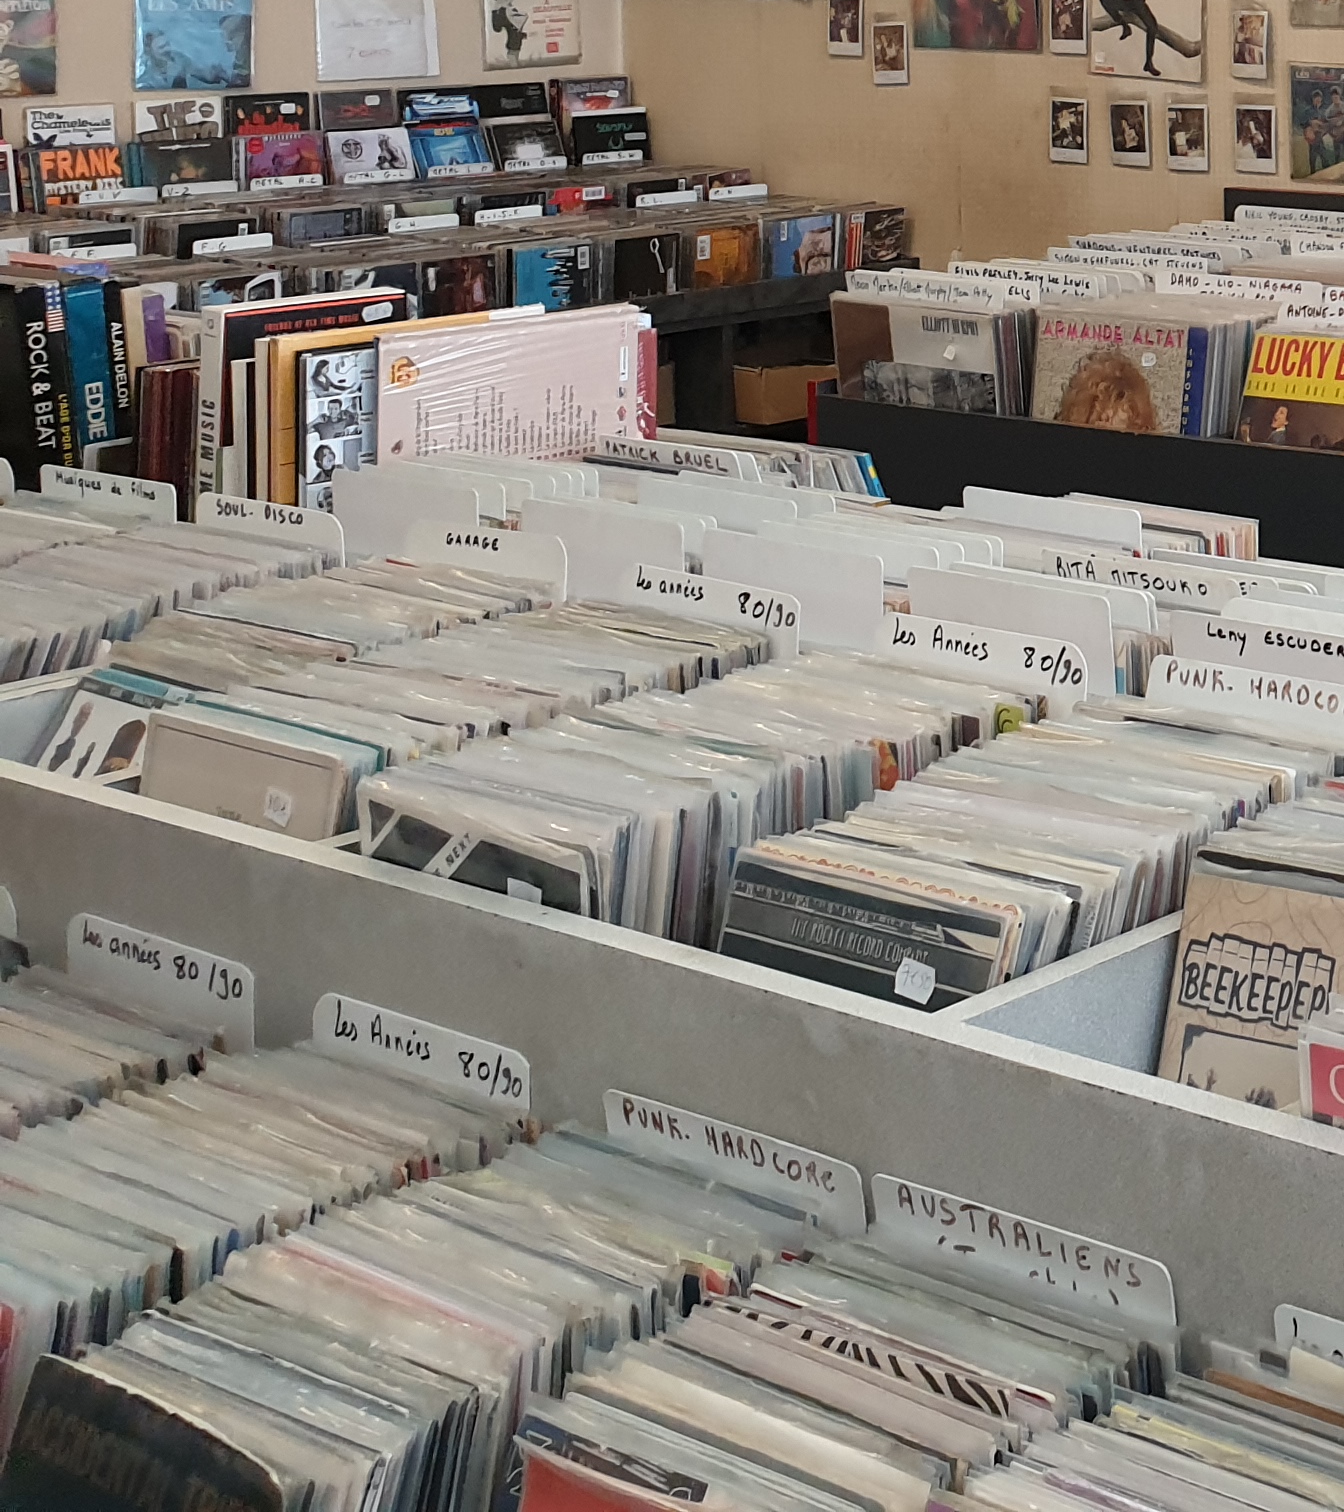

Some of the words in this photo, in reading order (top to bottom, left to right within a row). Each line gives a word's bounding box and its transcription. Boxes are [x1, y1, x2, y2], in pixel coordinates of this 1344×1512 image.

[39, 147, 124, 181] FRANK
[25, 320, 50, 380] ROCK
[110, 321, 125, 362] ALAIN
[1042, 320, 1123, 343] ARMANDE
[1251, 334, 1334, 381] LUCKY
[31, 381, 52, 396] &
[114, 362, 131, 410] DELON
[33, 399, 57, 449] BEAT
[84, 381, 107, 441] EDDIE
[201, 398, 217, 460] MUSIC
[604, 437, 668, 465] PATRICK
[673, 445, 730, 475] BRUEL
[263, 503, 305, 526] DISCO
[444, 530, 502, 554] GARAGE
[737, 588, 798, 632] 80/90
[1021, 644, 1084, 687] 80/90
[442, 830, 475, 869] NEXT
[457, 1048, 524, 1100] 80/90
[896, 1183, 1144, 1290] AUSTRALIENS
